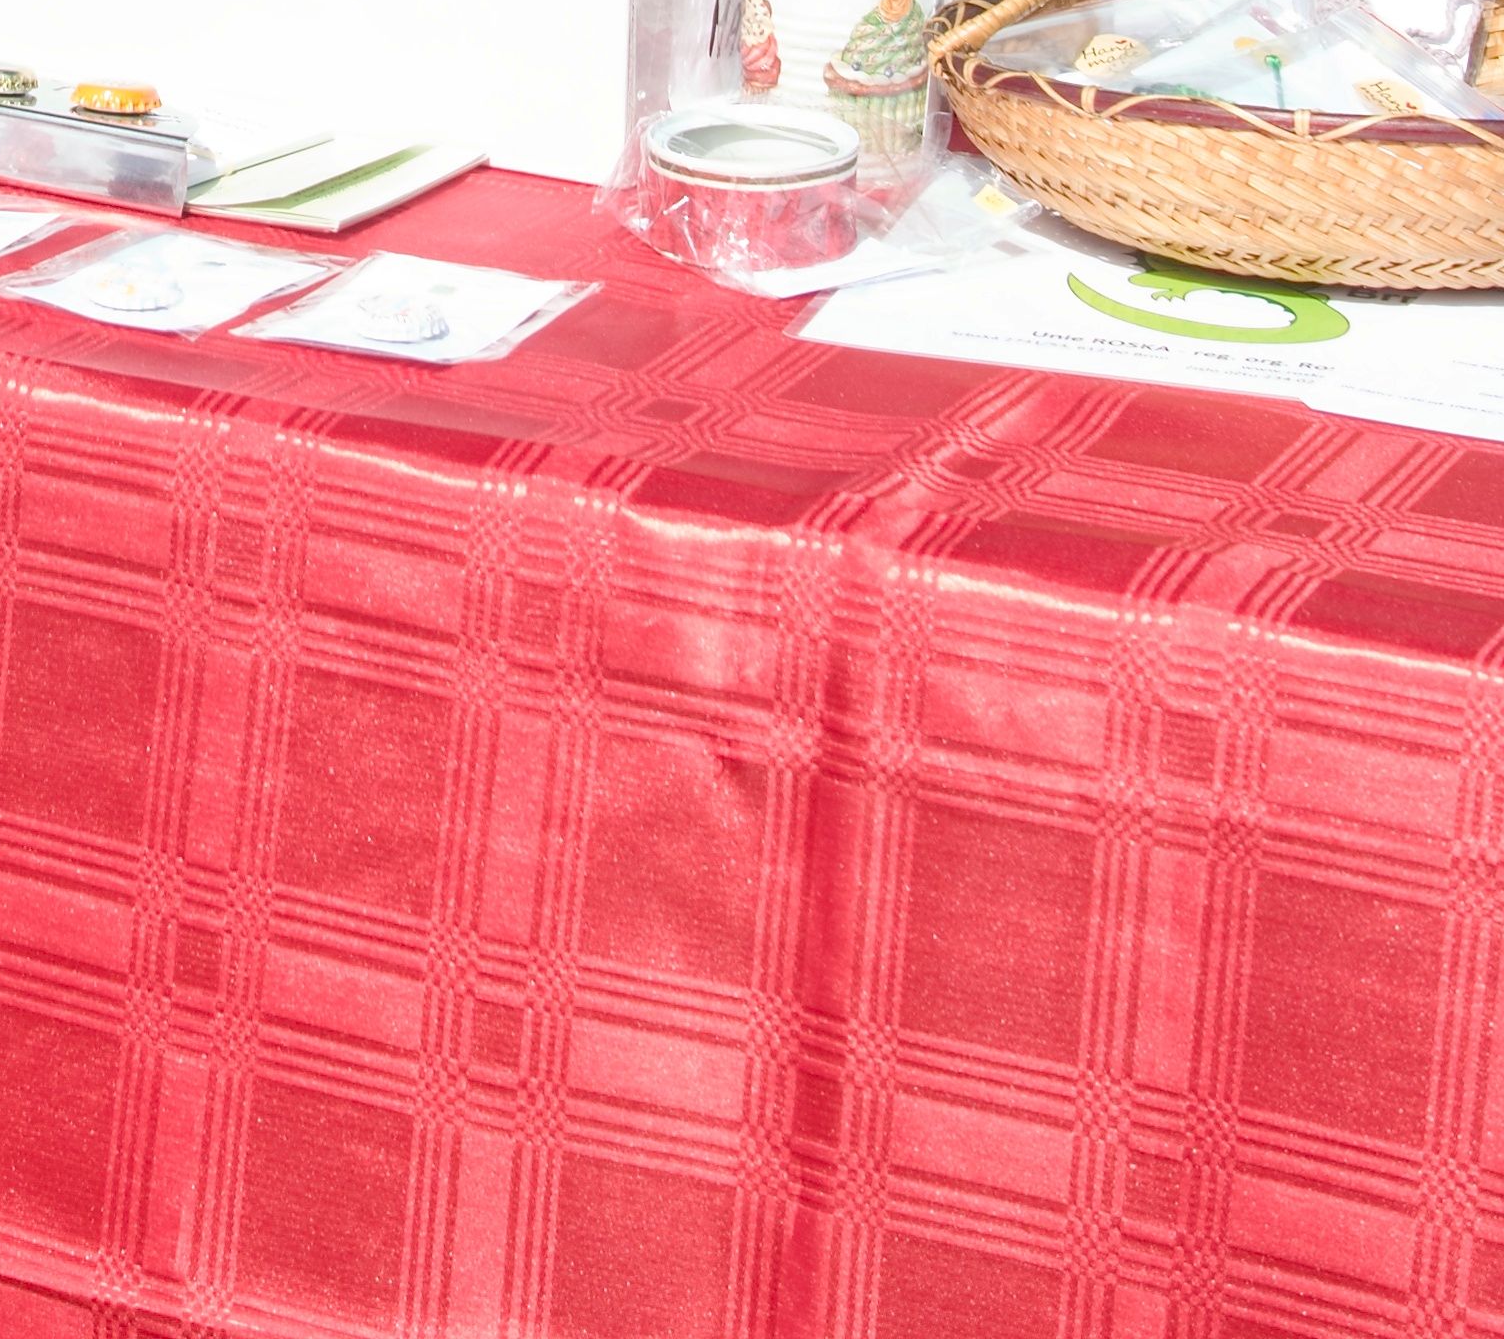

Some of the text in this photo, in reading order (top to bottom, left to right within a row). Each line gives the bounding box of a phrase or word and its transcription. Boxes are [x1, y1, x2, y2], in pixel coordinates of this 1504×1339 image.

[1083, 41, 1137, 61] Hand
[1030, 330, 1084, 343] Unie
[1091, 336, 1171, 353] ROSKA
[1192, 350, 1234, 362] reg.
[1244, 355, 1288, 369] org.
